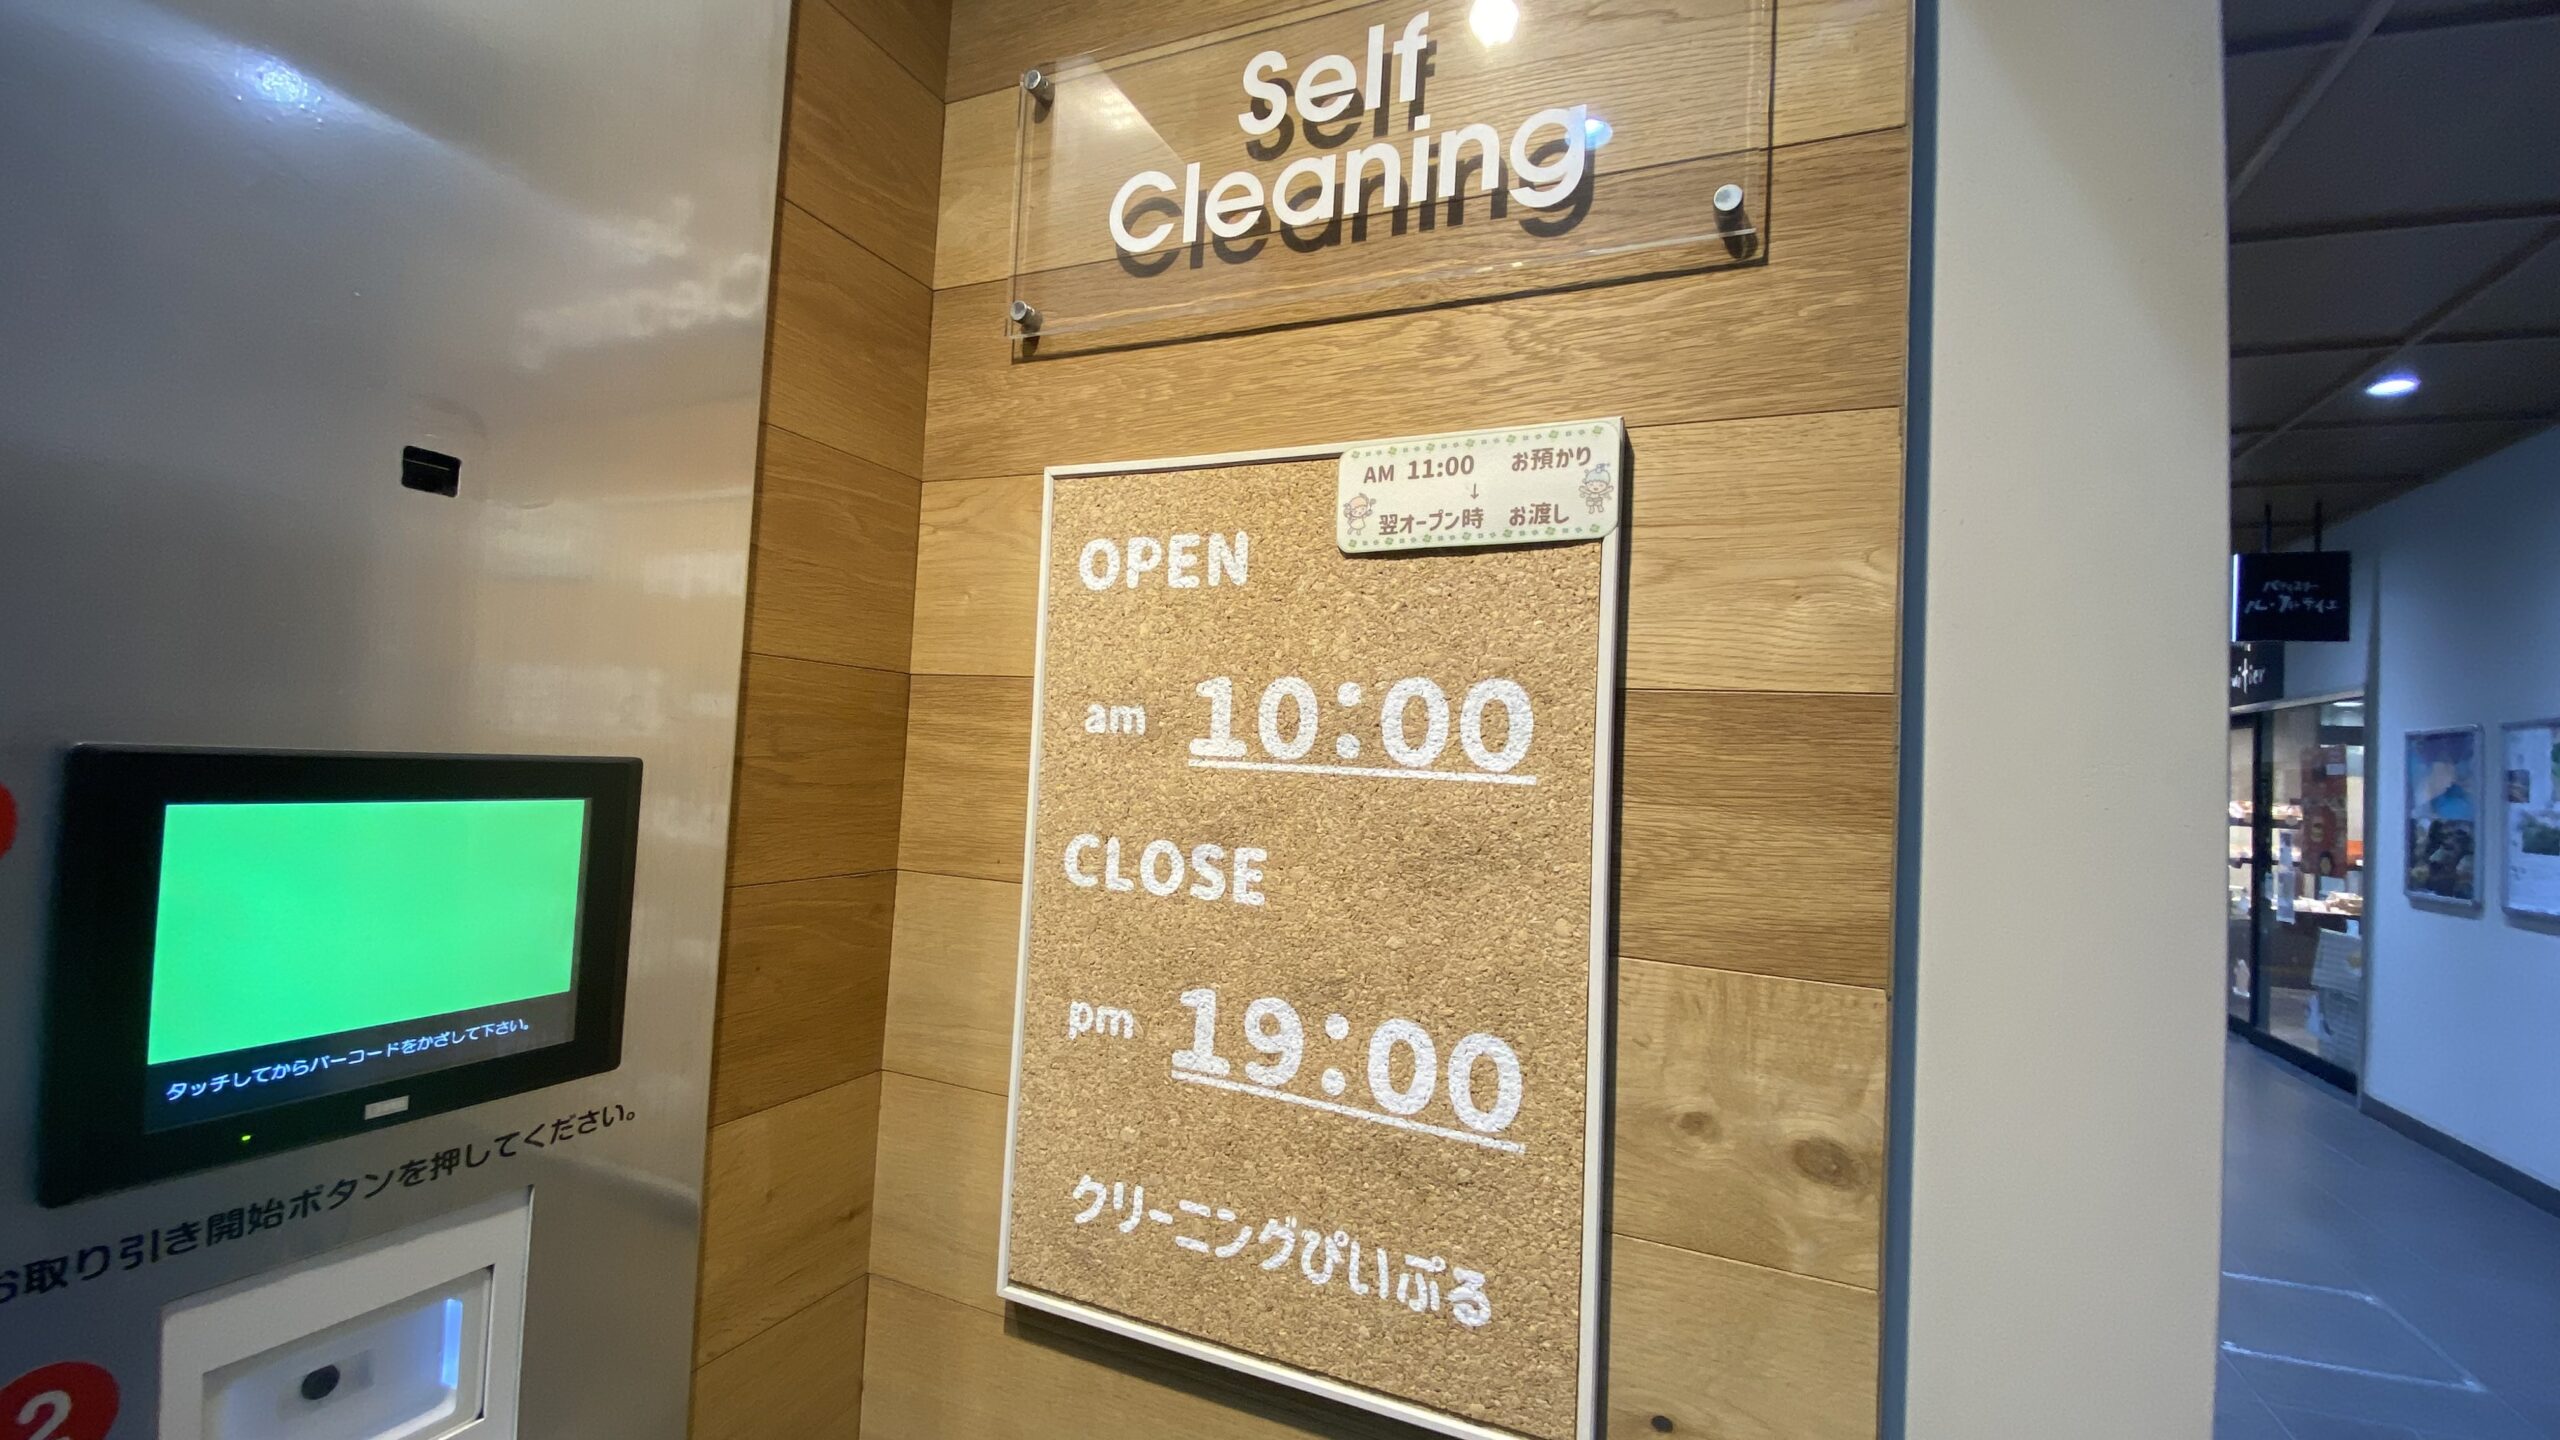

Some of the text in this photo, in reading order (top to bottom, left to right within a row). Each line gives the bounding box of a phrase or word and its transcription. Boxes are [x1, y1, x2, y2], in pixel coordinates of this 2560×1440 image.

[1238, 11, 1431, 136] Self
[1109, 104, 1588, 253] Cleaning
[1363, 446, 1592, 484] AM 11:00 お預かり
[1378, 502, 1570, 536] 翌オープン時 お渡し
[1078, 531, 1250, 591] OPEN
[1084, 676, 1535, 773] am 10:00
[1063, 833, 1268, 907] CLOSE
[165, 1018, 530, 1101] タッチしてからバーコードをかざして下さい。
[1069, 988, 1523, 1133] pm 19:00
[1072, 1175, 1492, 1327] クリーニングぴいぷる
[15, 1390, 72, 1440] 2
